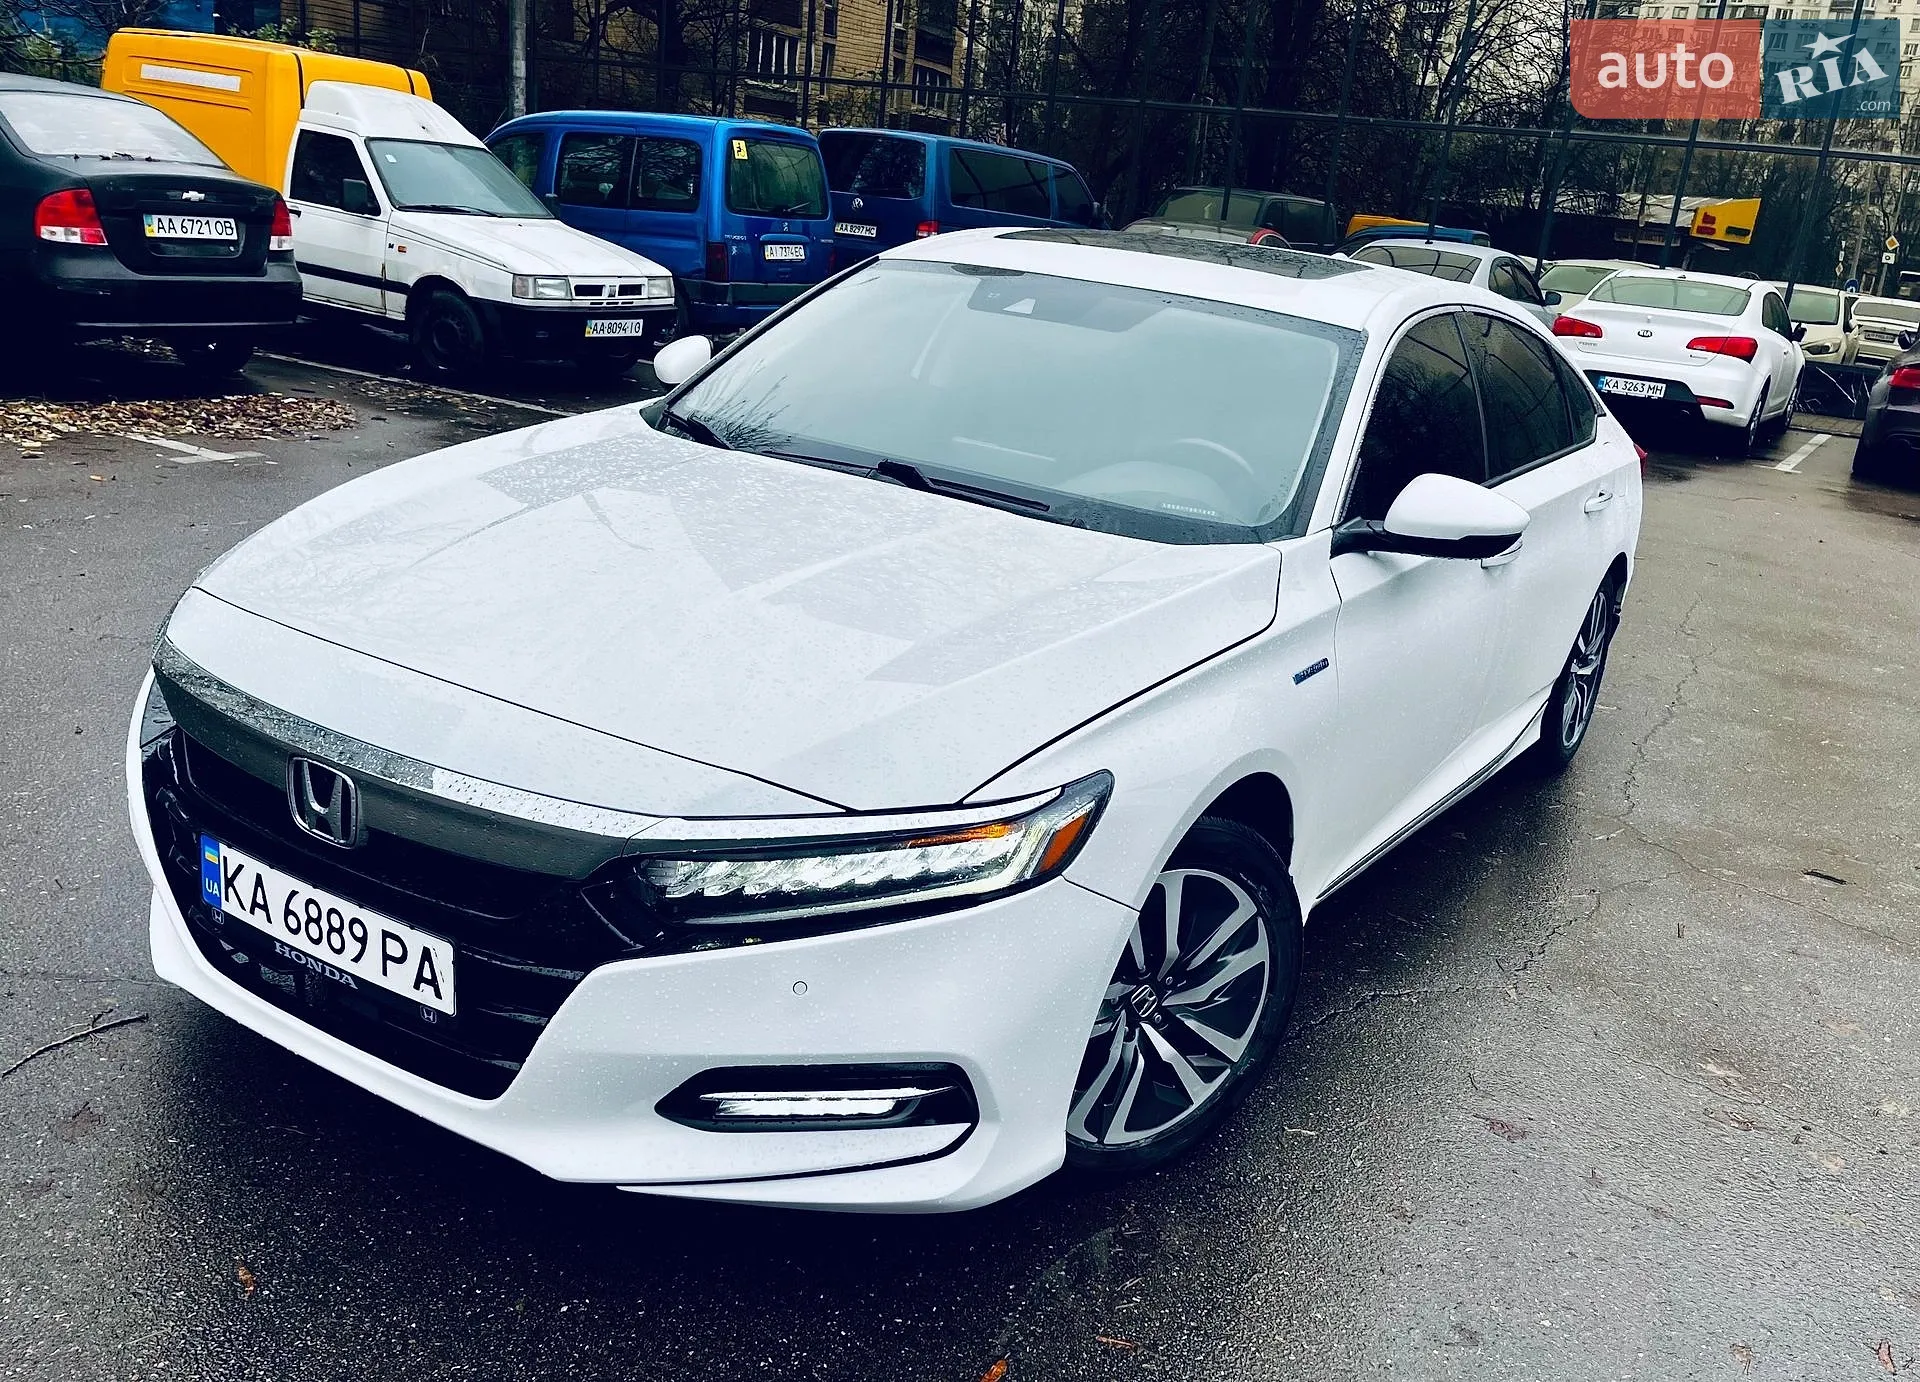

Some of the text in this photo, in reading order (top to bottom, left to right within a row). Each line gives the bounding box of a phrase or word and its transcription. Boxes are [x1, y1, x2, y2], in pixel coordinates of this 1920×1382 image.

[157, 218, 234, 236] AA 6721 OB
[591, 322, 605, 335] AA
[606, 322, 627, 335] 8094
[1604, 379, 1663, 395] KA 3263 MH
[205, 878, 220, 897] UA
[222, 855, 443, 1001] KA 6889 PA
[273, 940, 359, 990] HONDA
